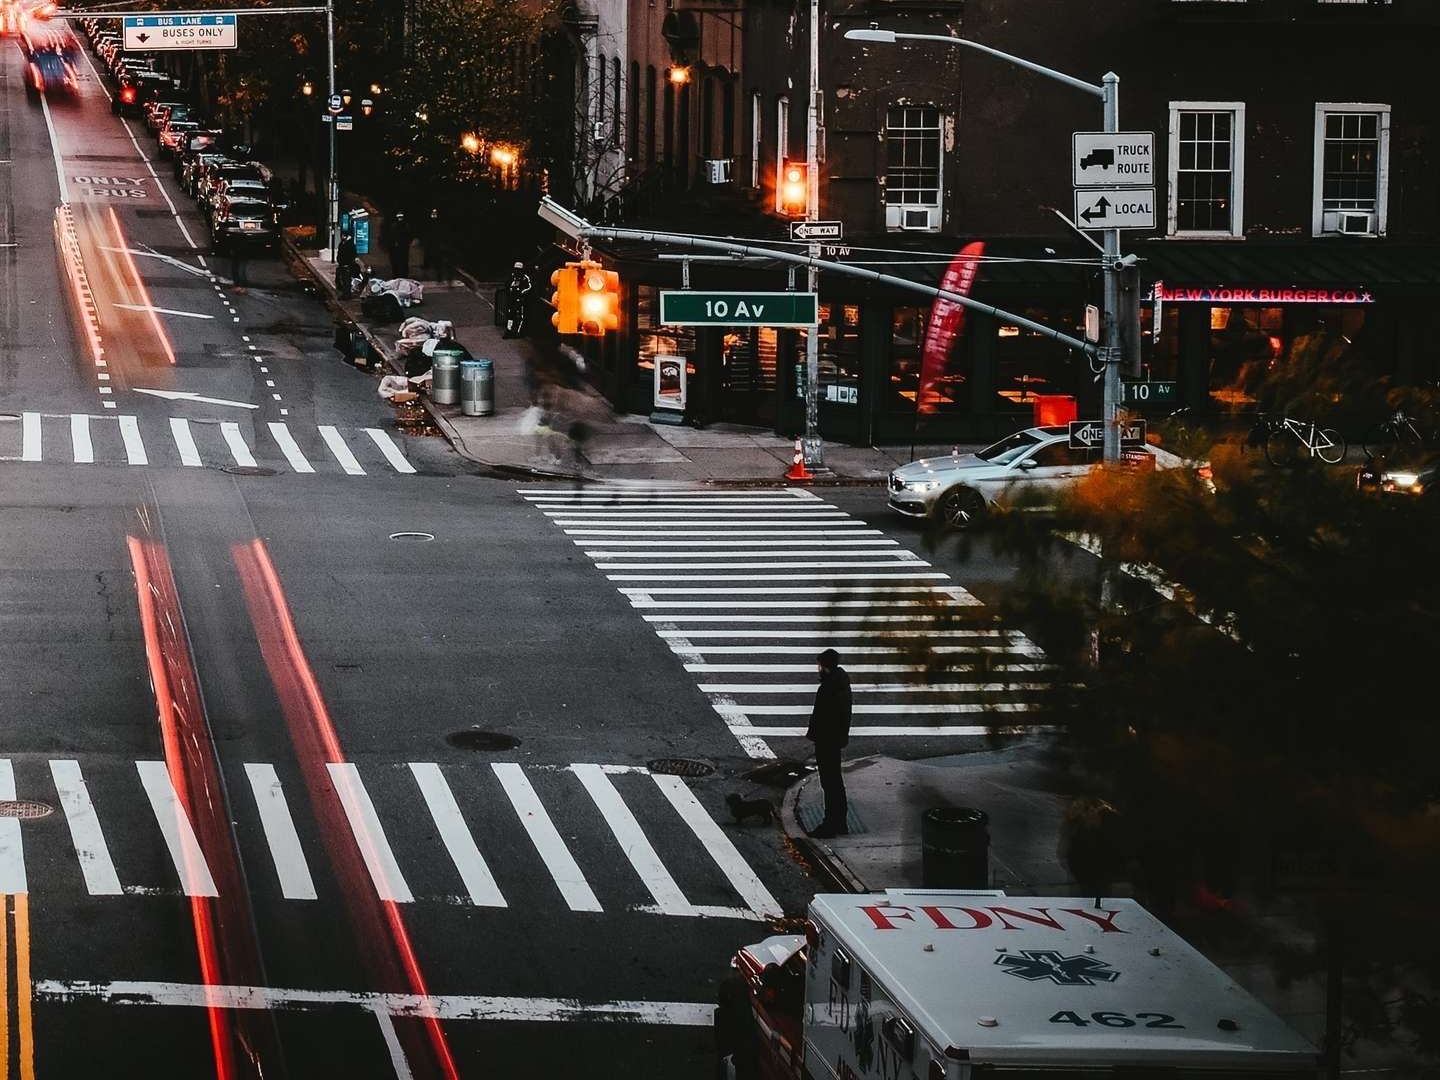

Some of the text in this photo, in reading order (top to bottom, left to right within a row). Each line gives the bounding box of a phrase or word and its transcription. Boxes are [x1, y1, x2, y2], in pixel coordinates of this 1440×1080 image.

[158, 17, 202, 25] BUS LANE
[162, 28, 224, 38] BUSES ONLY
[1117, 145, 1150, 155] TRUCK
[1117, 163, 1150, 174] ROUTE
[74, 176, 146, 185] ONLY
[89, 189, 147, 198] BUS
[1115, 203, 1152, 214] LOCAL
[798, 227, 814, 235] ONE
[826, 247, 836, 256] 10
[1162, 289, 1357, 302] NEW YORK BURGER CO
[705, 300, 765, 318] 10 Av
[1132, 384, 1171, 400] 10 Av
[1081, 428, 1136, 440] ONE AY
[857, 905, 1133, 934] FDNY
[1048, 1009, 1187, 1029] 462
